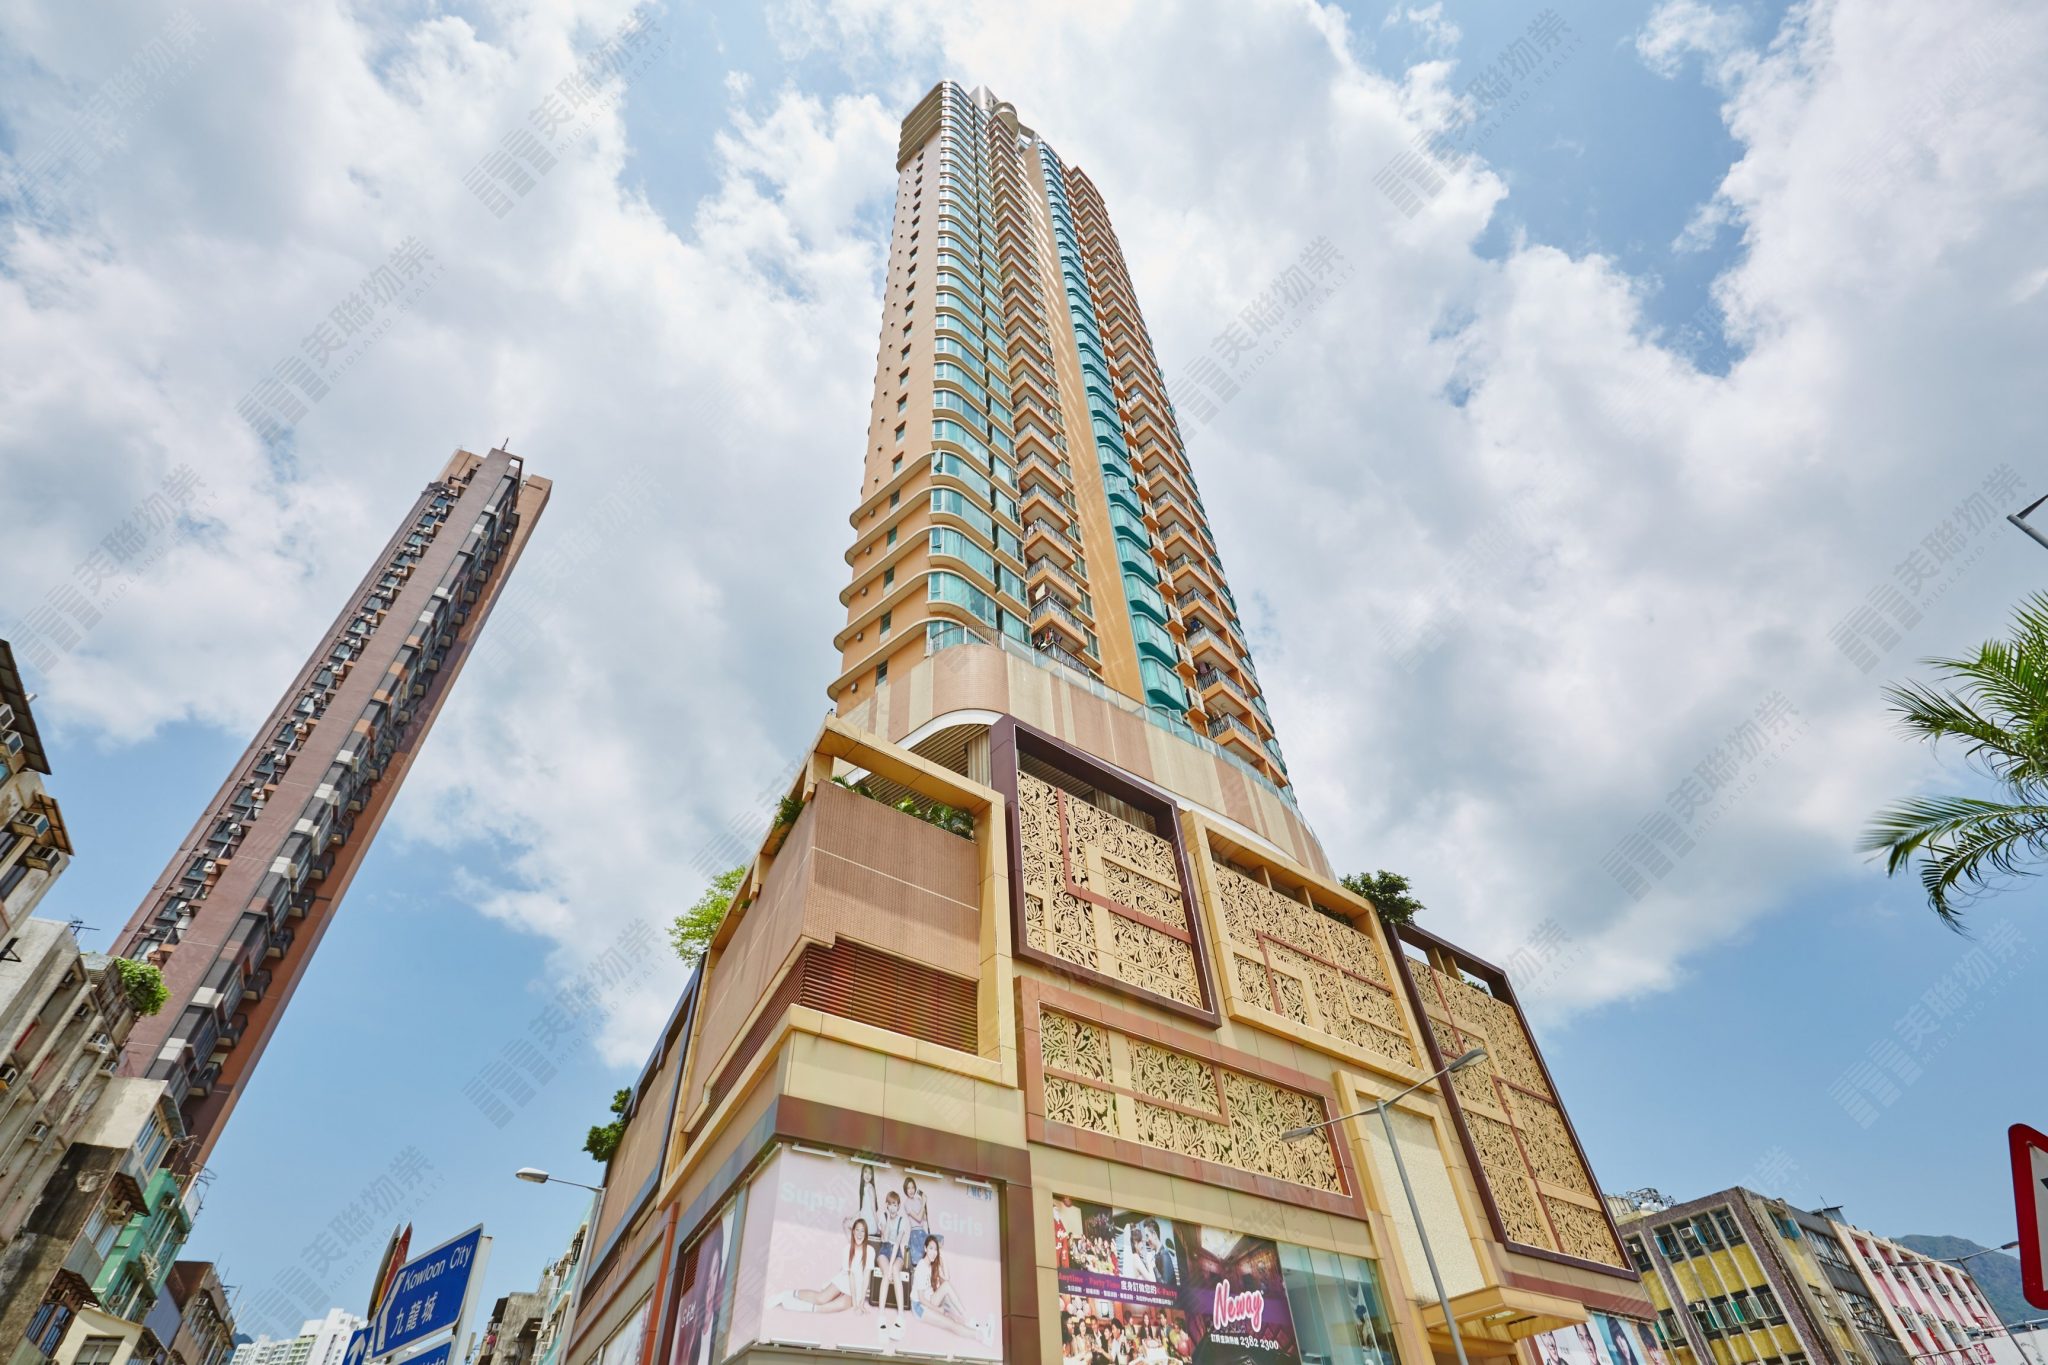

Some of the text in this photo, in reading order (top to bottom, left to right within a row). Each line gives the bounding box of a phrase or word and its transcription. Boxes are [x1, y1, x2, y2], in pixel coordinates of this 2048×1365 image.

[780, 1181, 848, 1214] Super
[938, 1211, 984, 1237] Girls
[402, 1244, 473, 1293] Kowloon City
[389, 1291, 439, 1339] 九龍城
[1213, 1278, 1264, 1332] Neway
[1240, 1335, 1259, 1348] 2382
[1260, 1339, 1279, 1351] 2300
